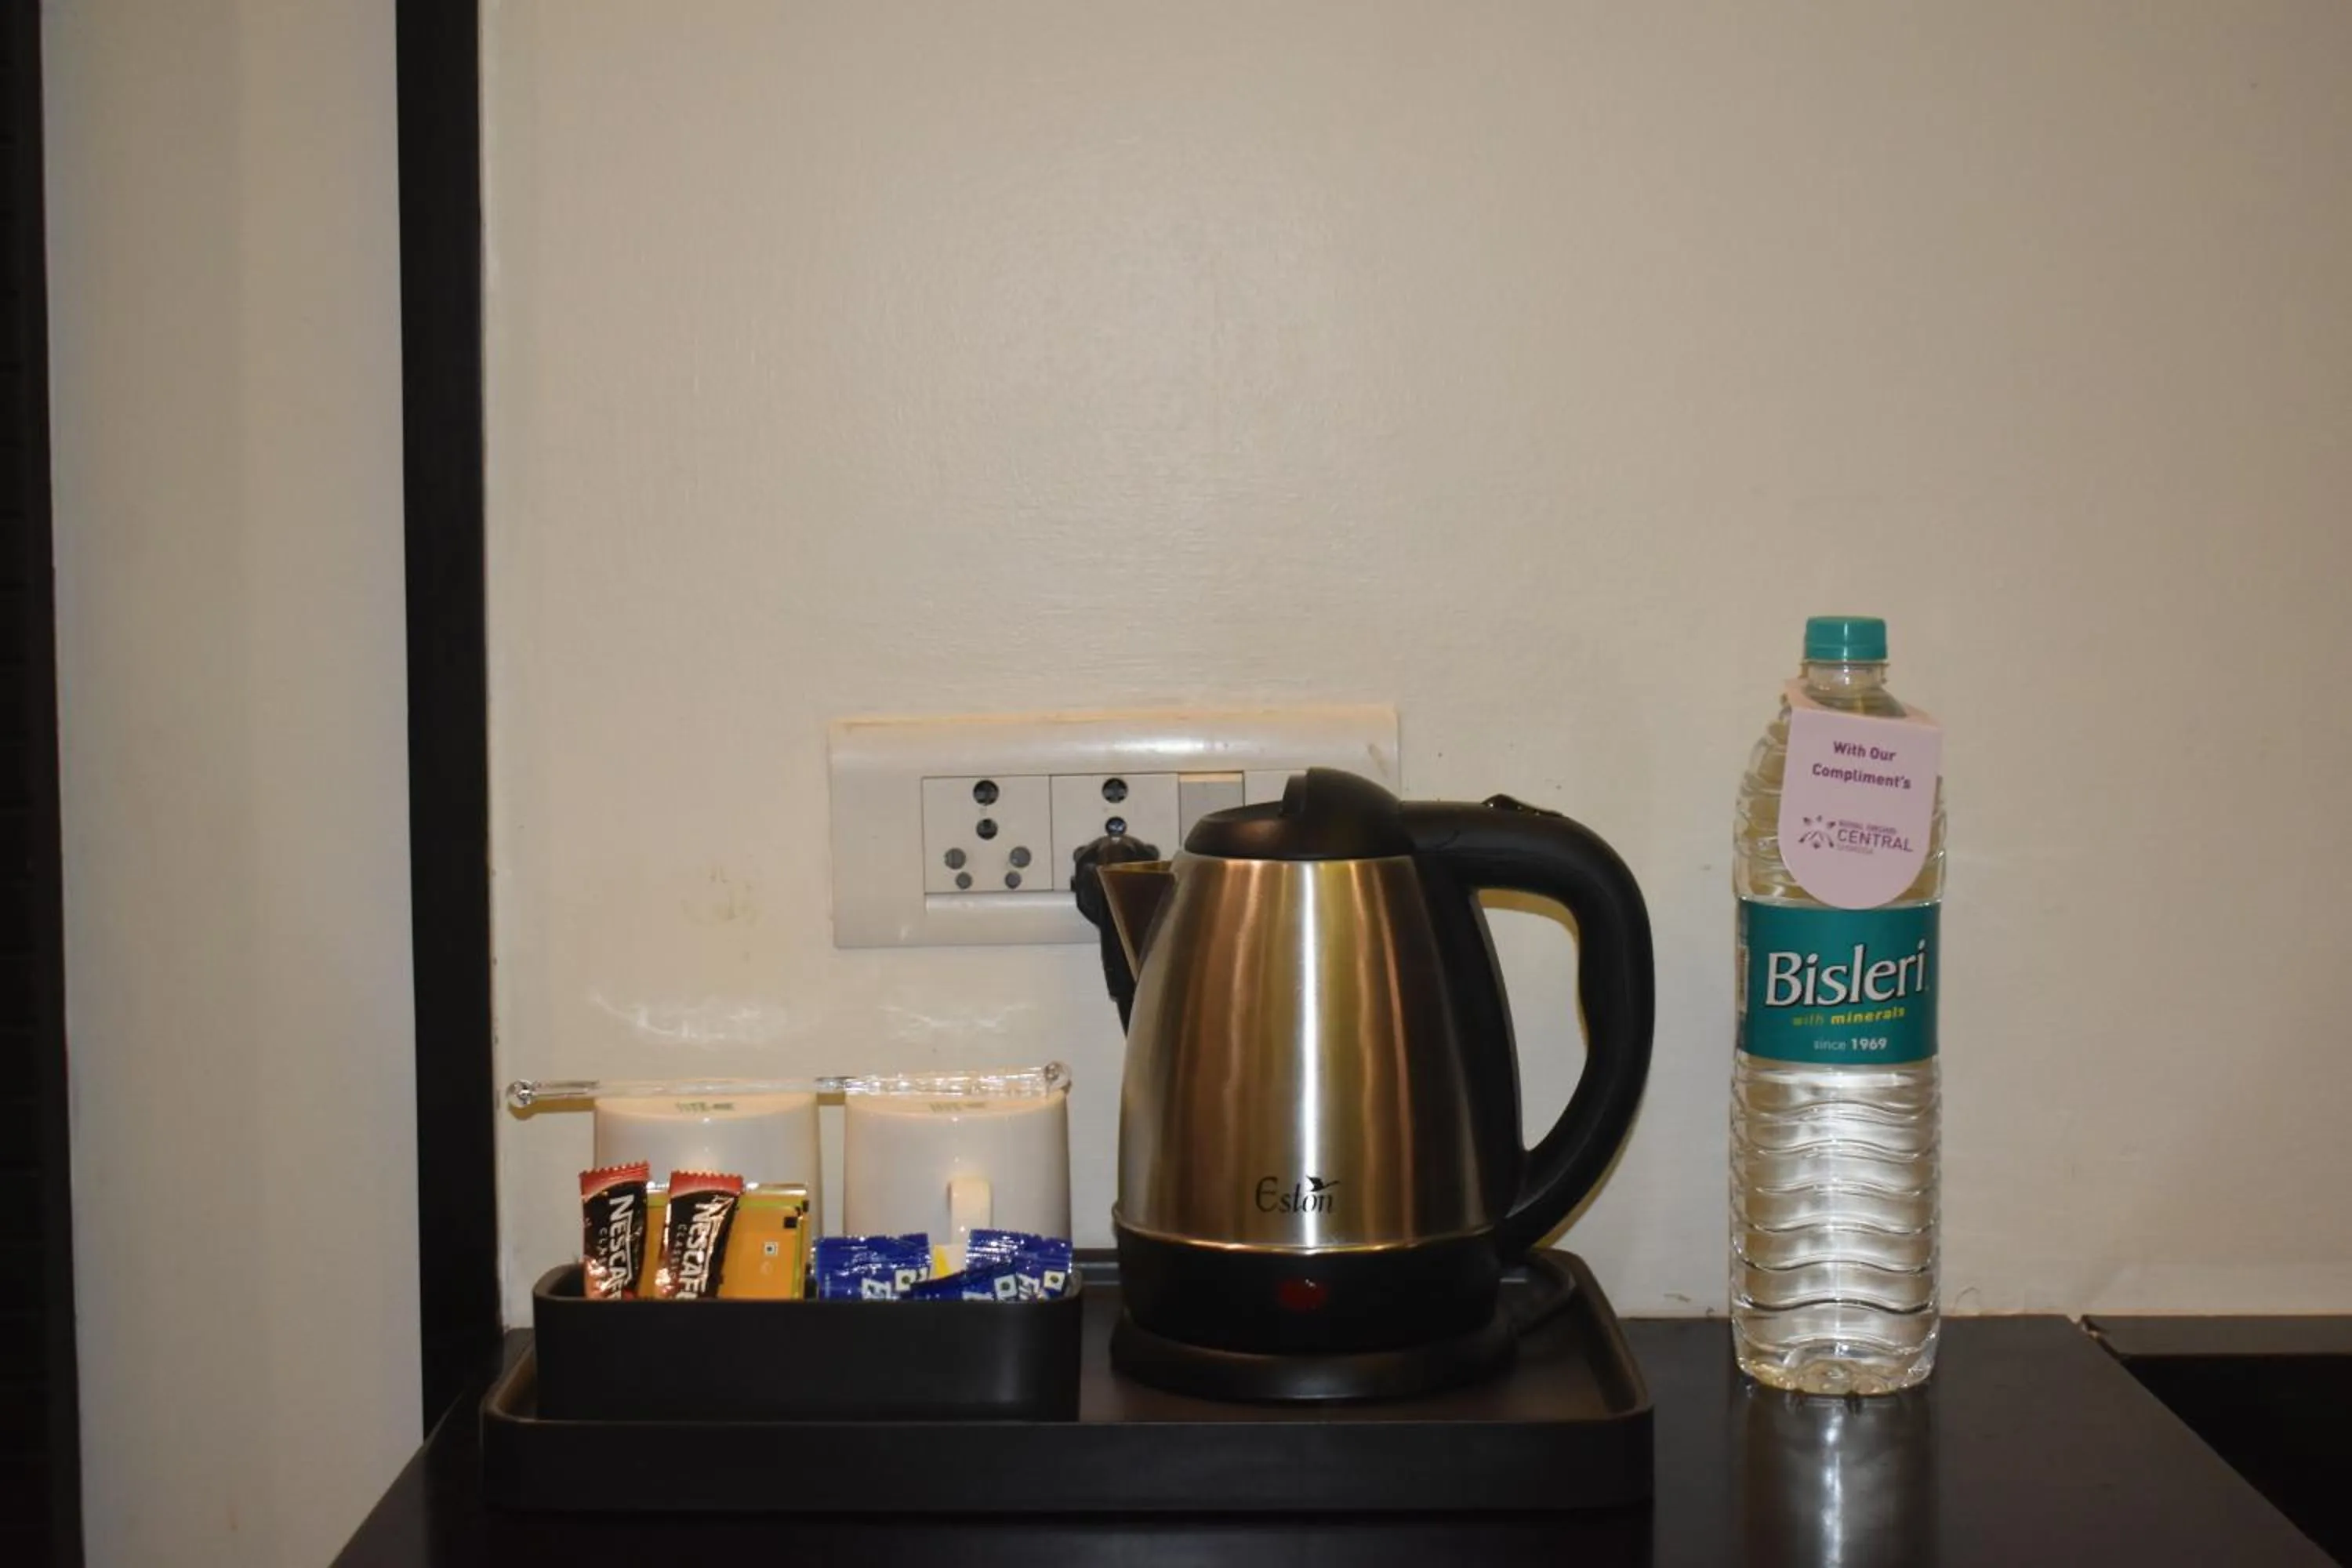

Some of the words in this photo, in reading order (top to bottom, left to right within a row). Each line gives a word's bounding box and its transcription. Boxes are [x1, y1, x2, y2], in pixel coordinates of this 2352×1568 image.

[1833, 741, 1866, 759] With
[1871, 746, 1896, 762] Our
[1812, 763, 1911, 789] Compliment's
[1837, 828, 1913, 853] CENTRAL
[1766, 939, 1926, 1007] Bisleri
[1792, 1012, 1825, 1026] with
[1831, 1006, 1905, 1025] minerals
[1813, 1039, 1846, 1051] since
[1851, 1037, 1888, 1051] 1969
